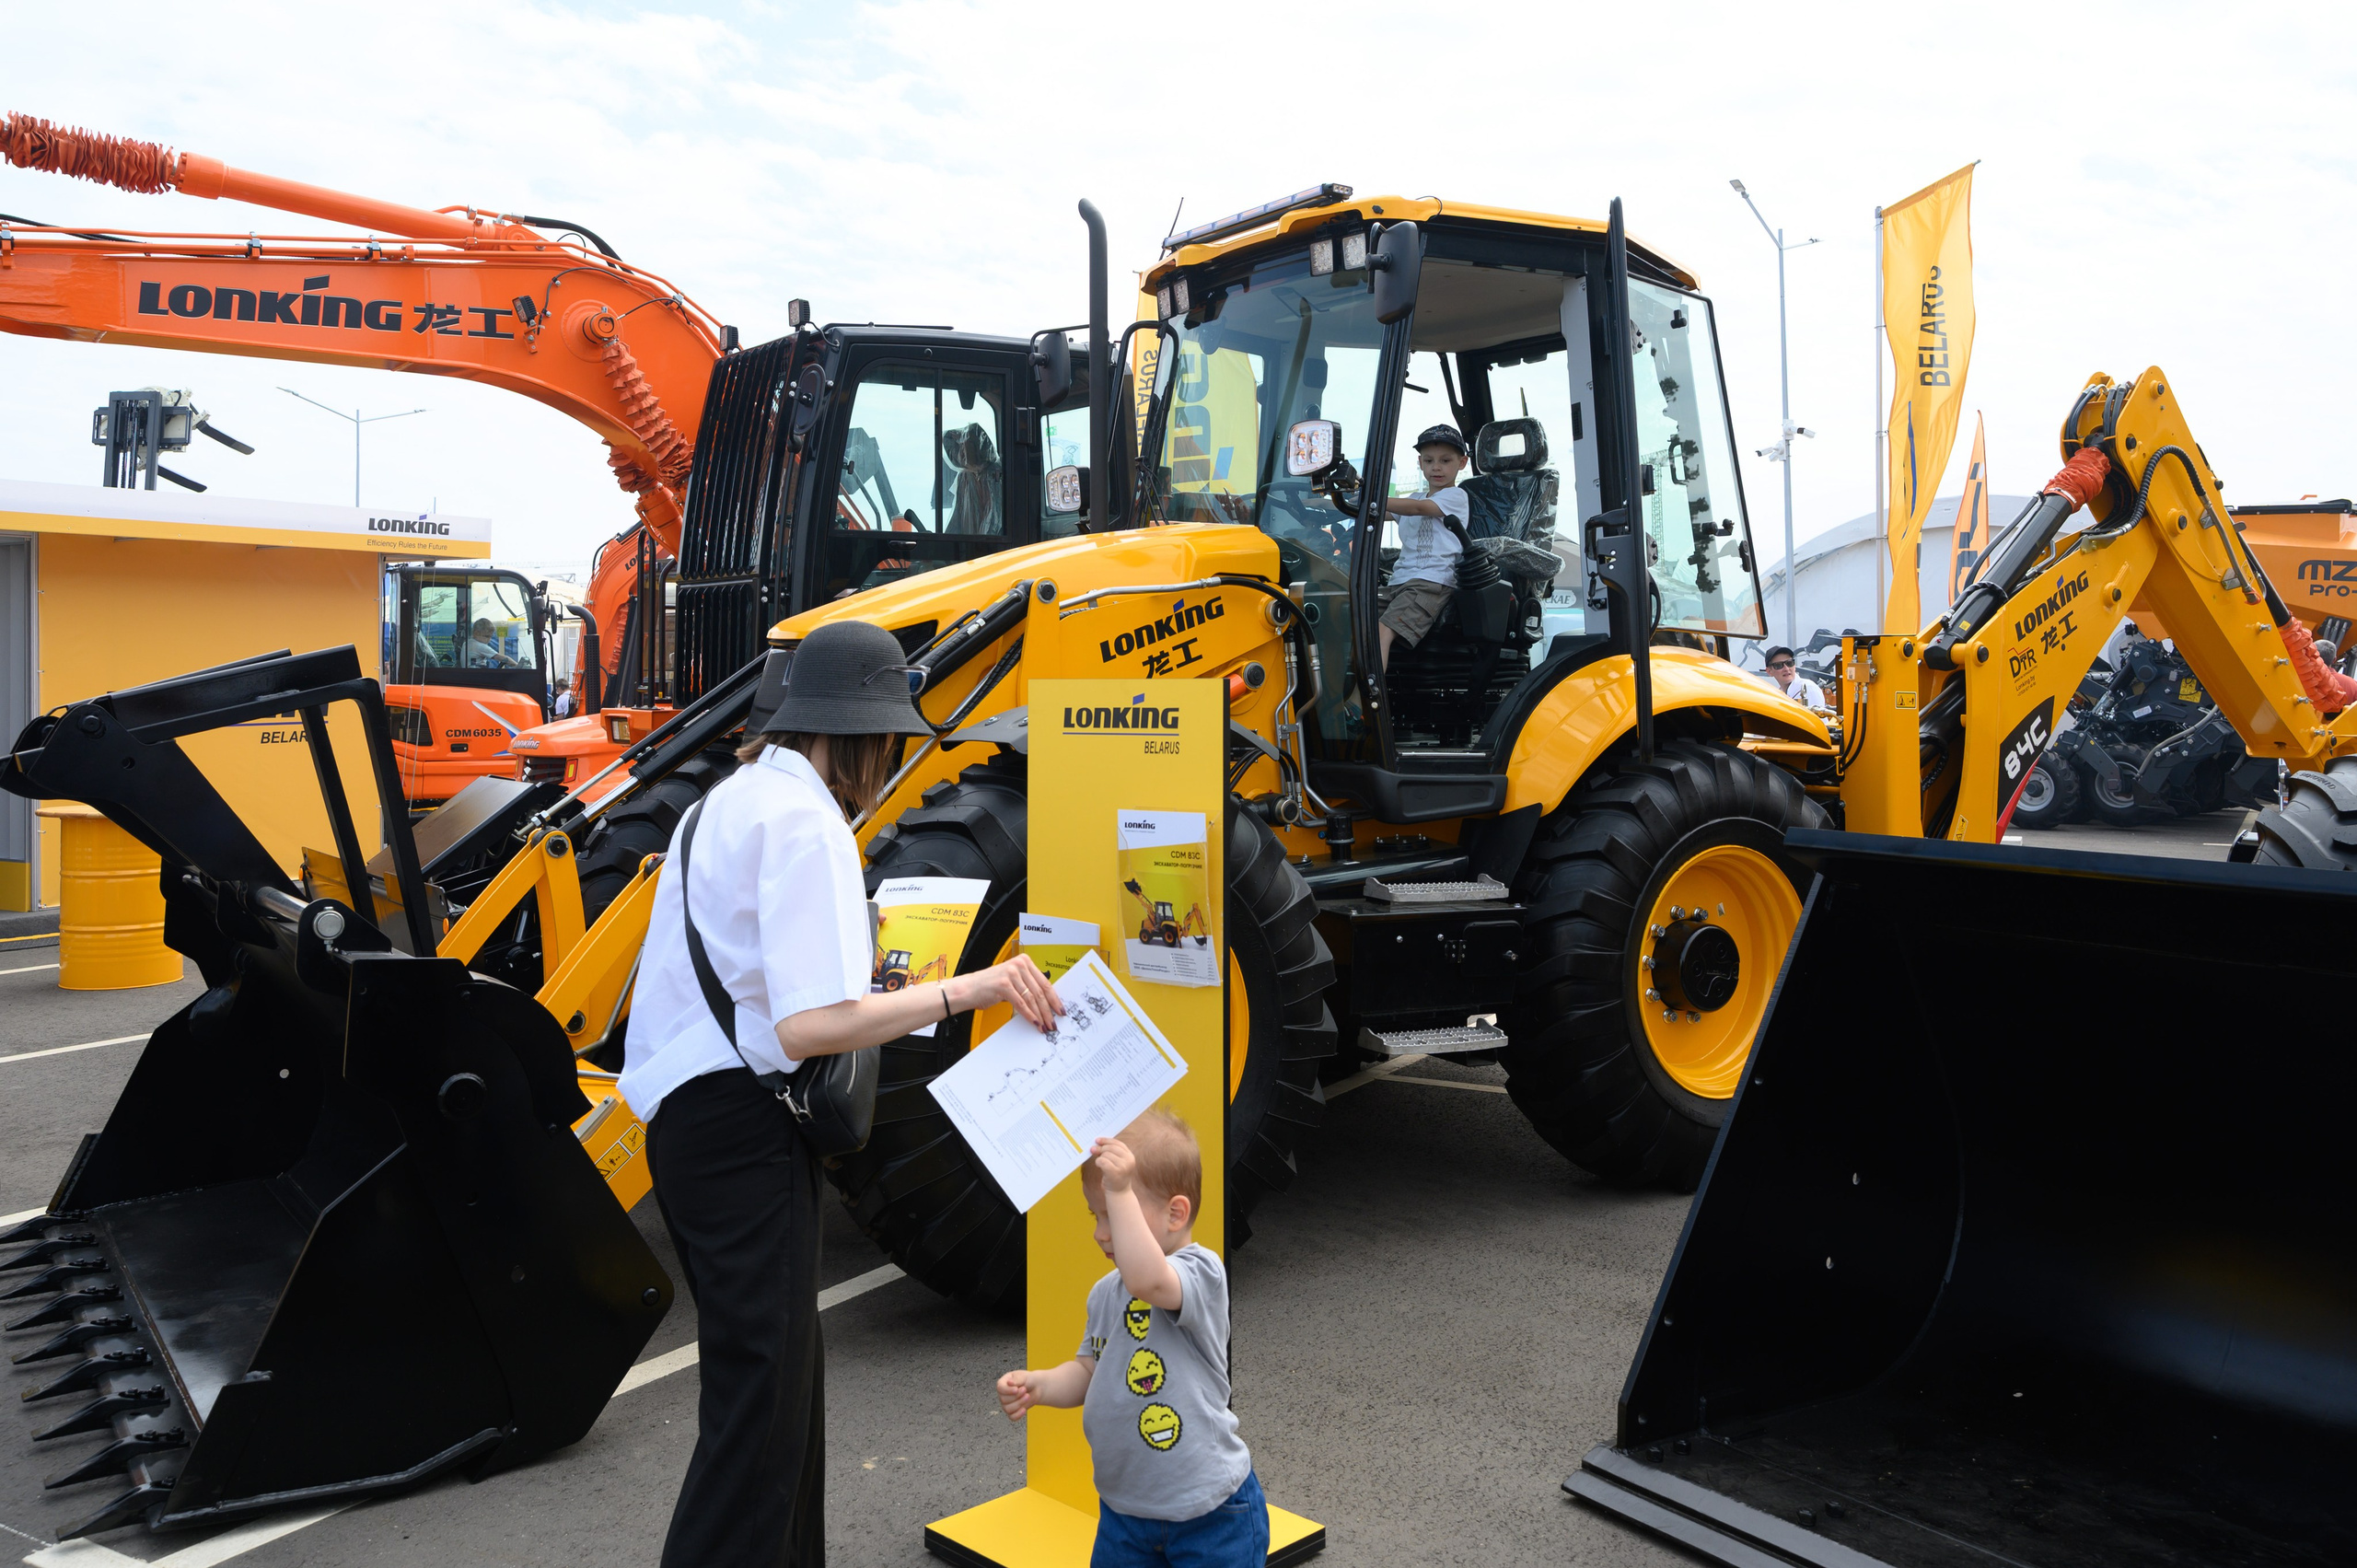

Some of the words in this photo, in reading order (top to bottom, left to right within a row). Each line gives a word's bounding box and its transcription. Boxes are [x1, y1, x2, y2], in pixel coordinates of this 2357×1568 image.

[412, 303, 515, 339] 龙工
[366, 540, 397, 549] Efficiency
[399, 540, 416, 549] Rules
[261, 731, 308, 744] BELAR
[1144, 740, 1180, 755] BELARUS
[2004, 715, 2047, 780] 84C
[1170, 851, 1186, 859] CDM
[952, 910, 970, 918] 83C
